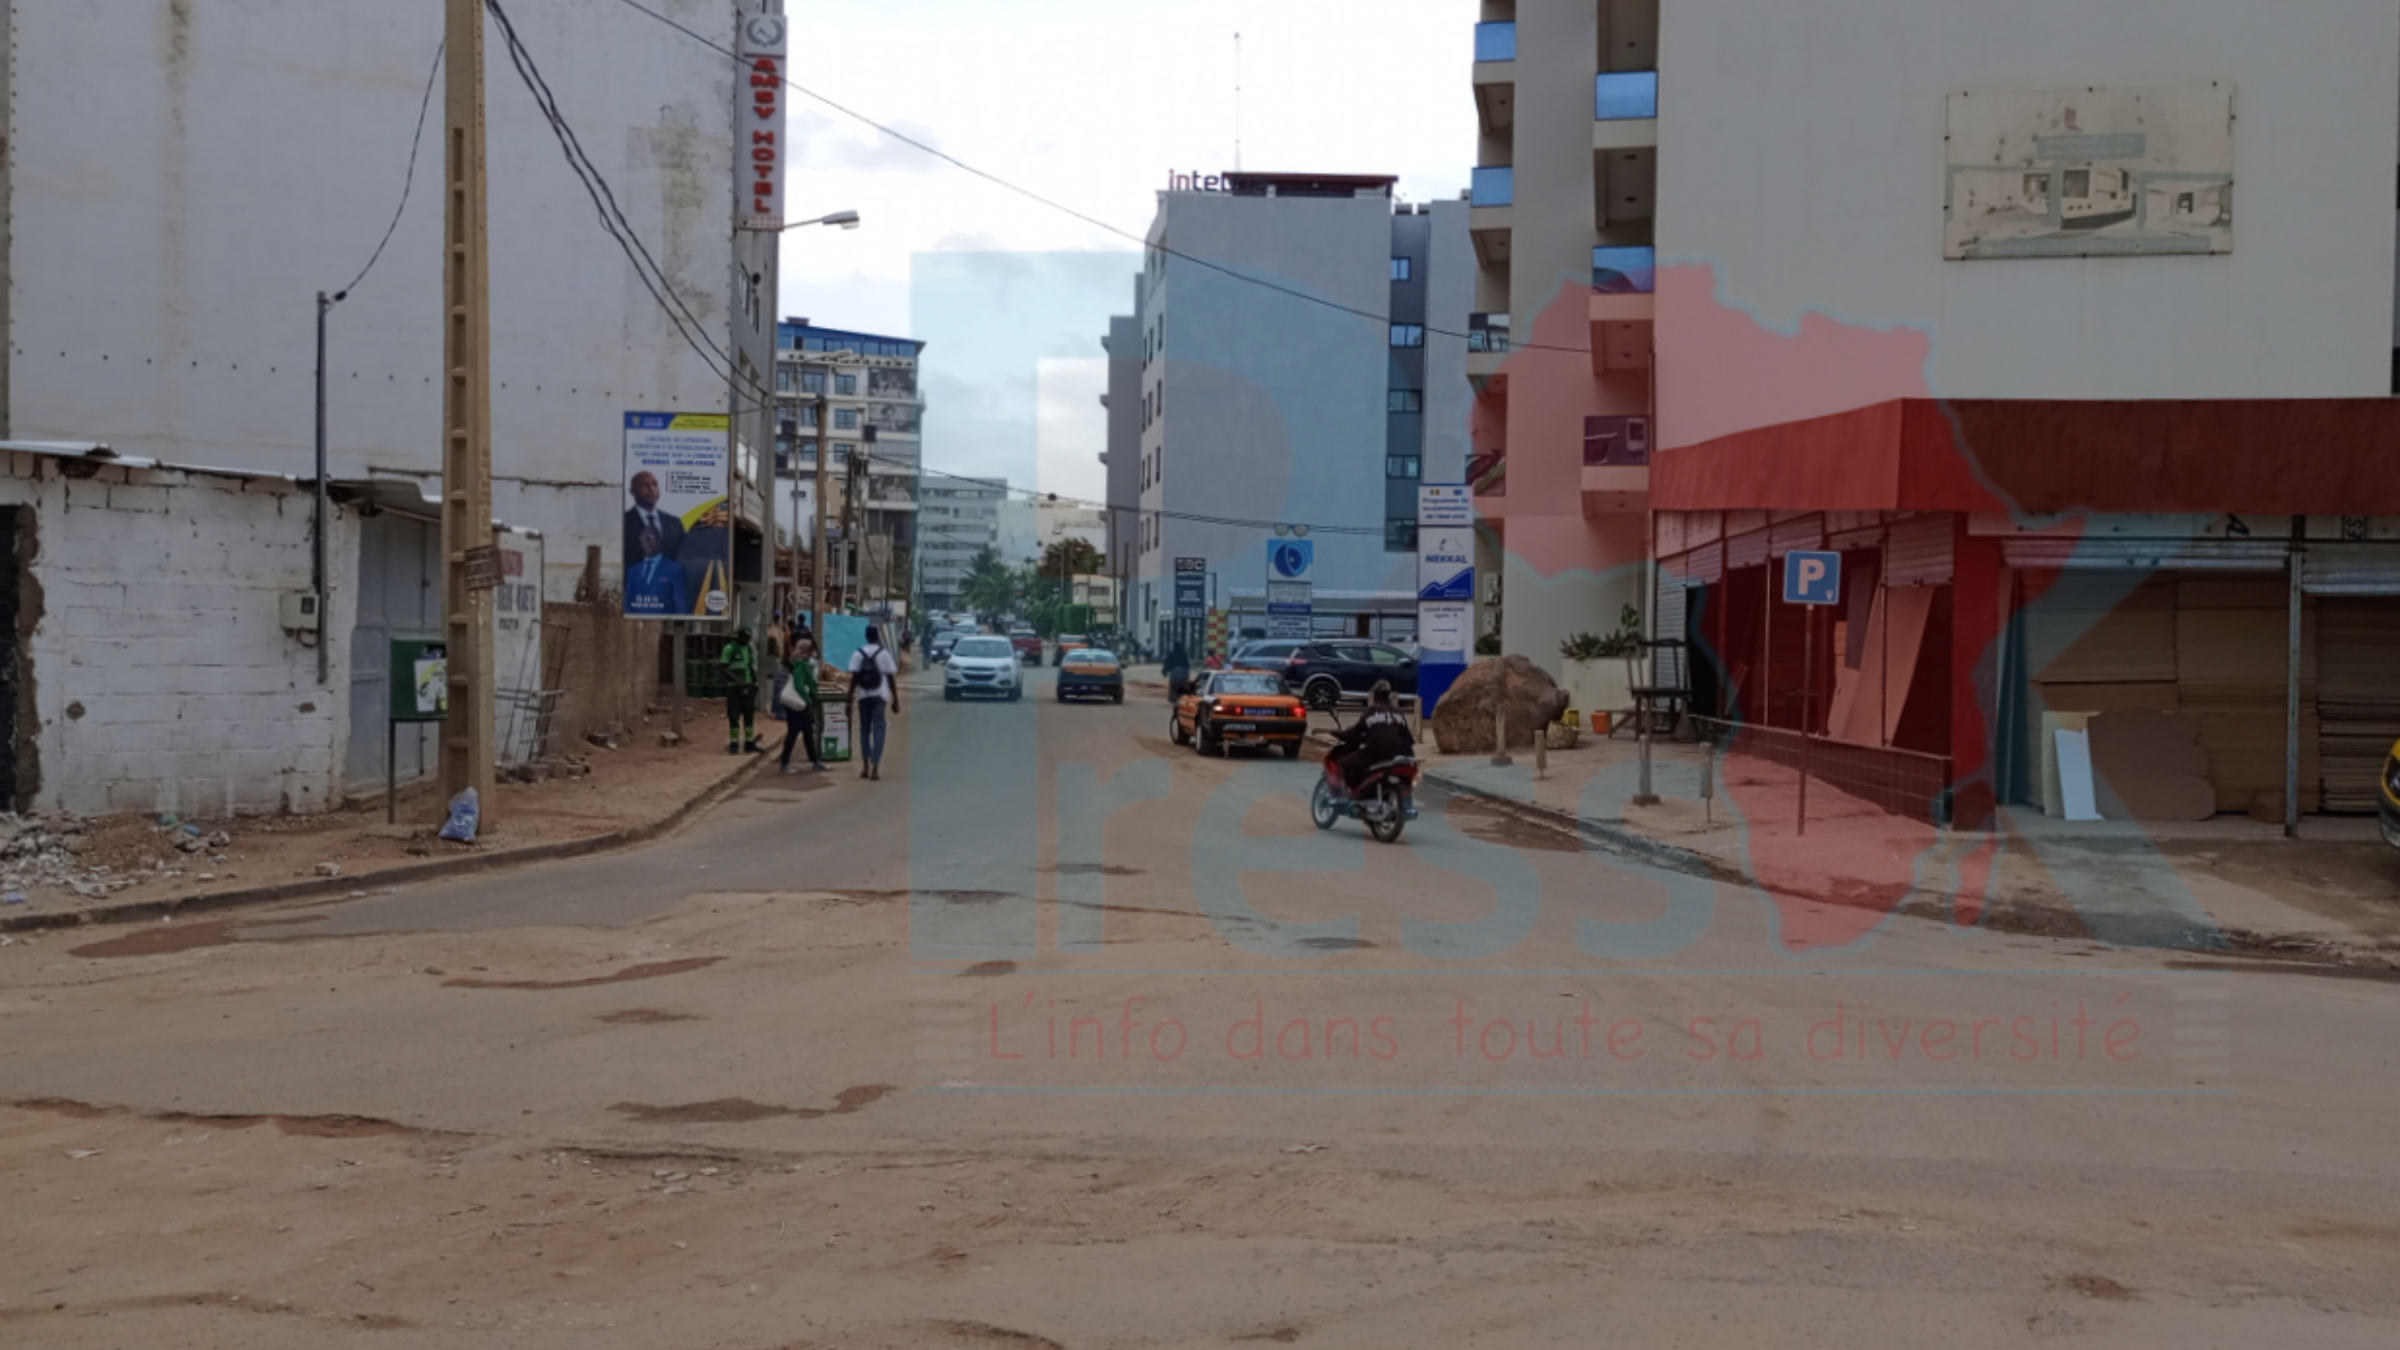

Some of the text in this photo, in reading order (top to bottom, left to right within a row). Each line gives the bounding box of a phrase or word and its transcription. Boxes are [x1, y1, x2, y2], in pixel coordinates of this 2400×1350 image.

[752, 130, 776, 213] HOTEL
[1425, 554, 1468, 564] NEKKAL
[1798, 558, 1826, 595] P
